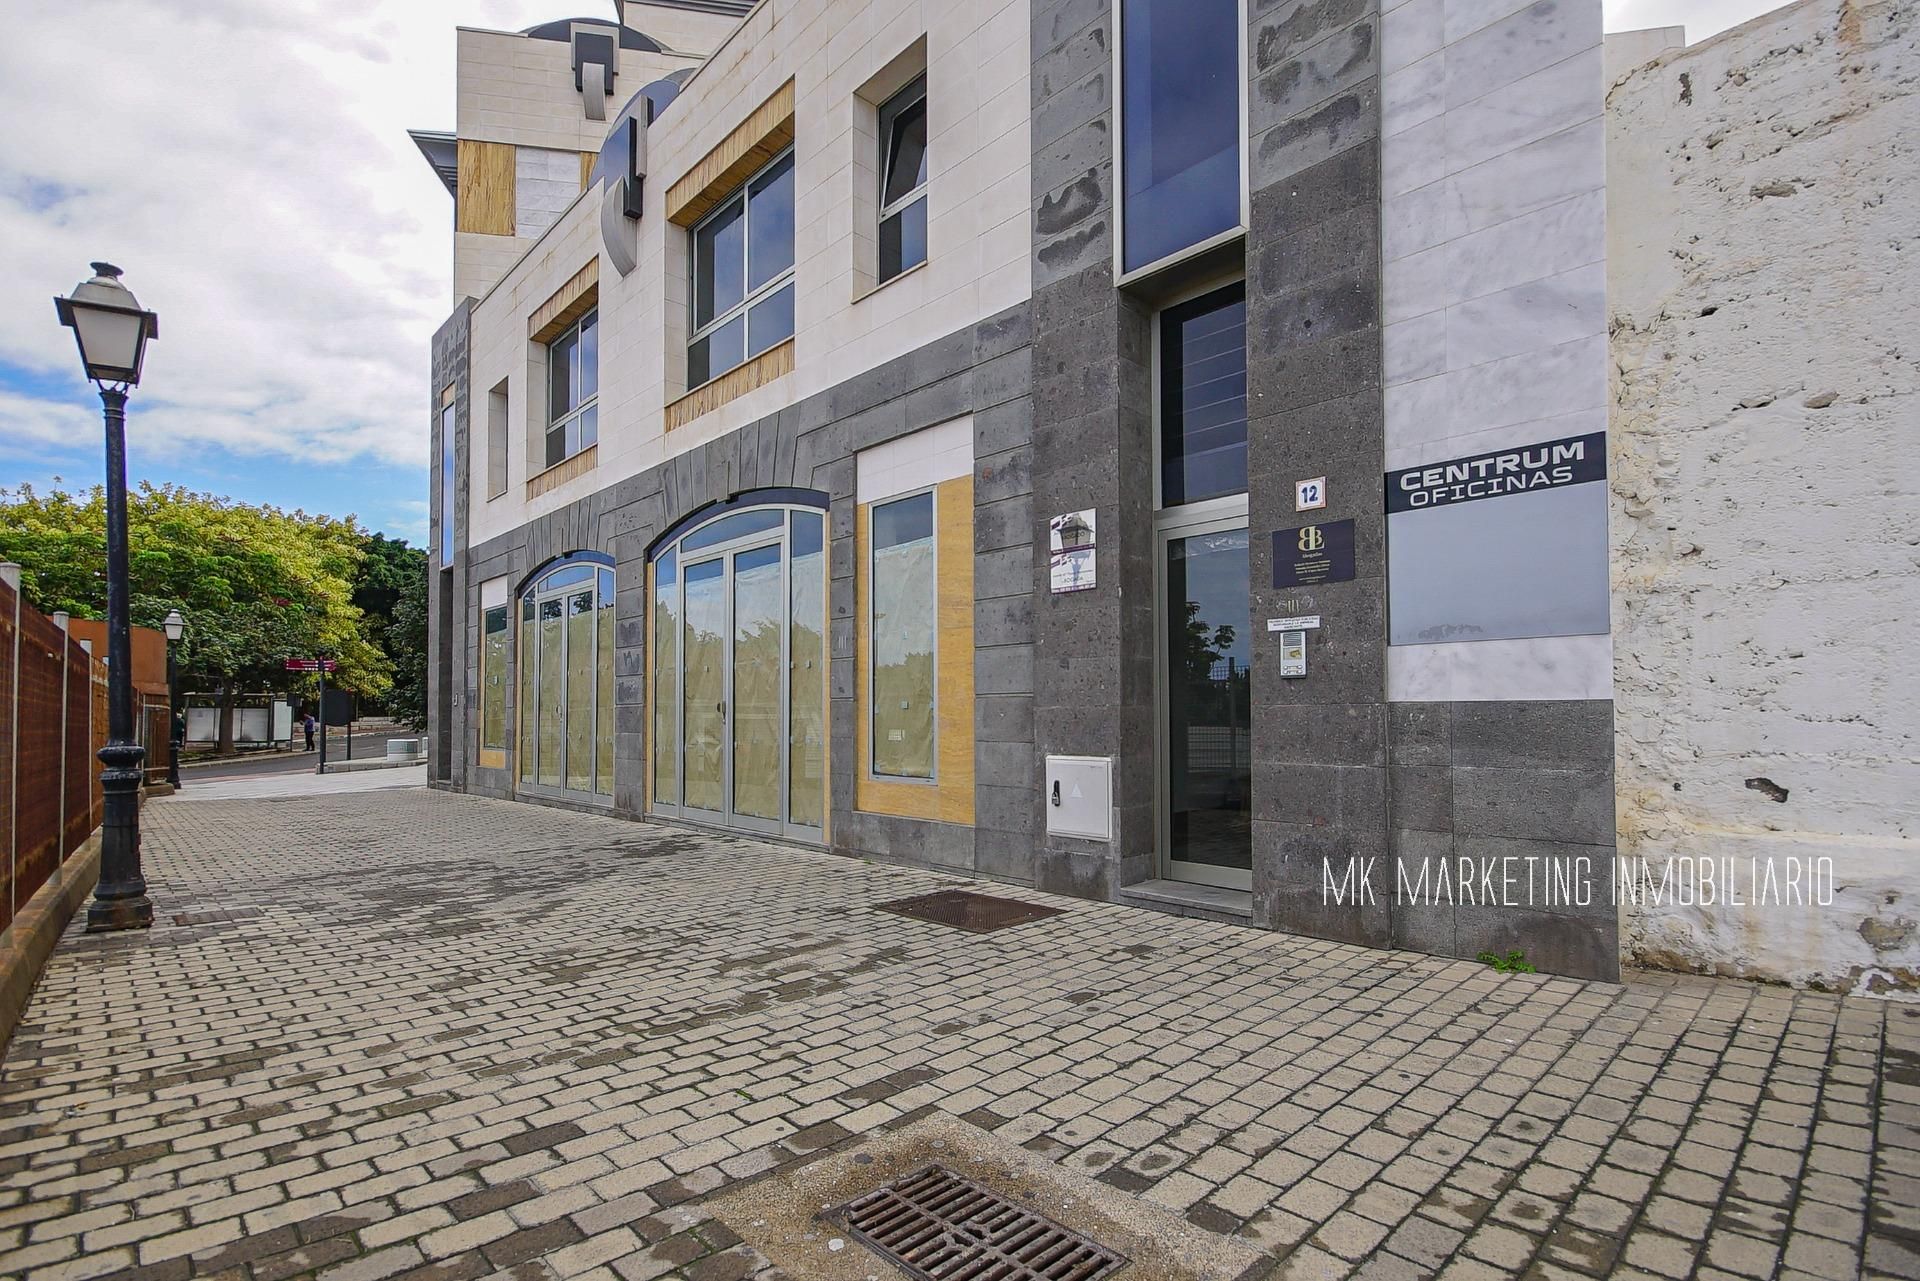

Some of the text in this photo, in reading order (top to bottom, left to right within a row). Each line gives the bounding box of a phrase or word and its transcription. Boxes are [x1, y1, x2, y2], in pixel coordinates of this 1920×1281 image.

[1400, 441, 1584, 490] CENTRUM
[1301, 485, 1318, 503] 12
[1410, 466, 1573, 507] OFICINAS
